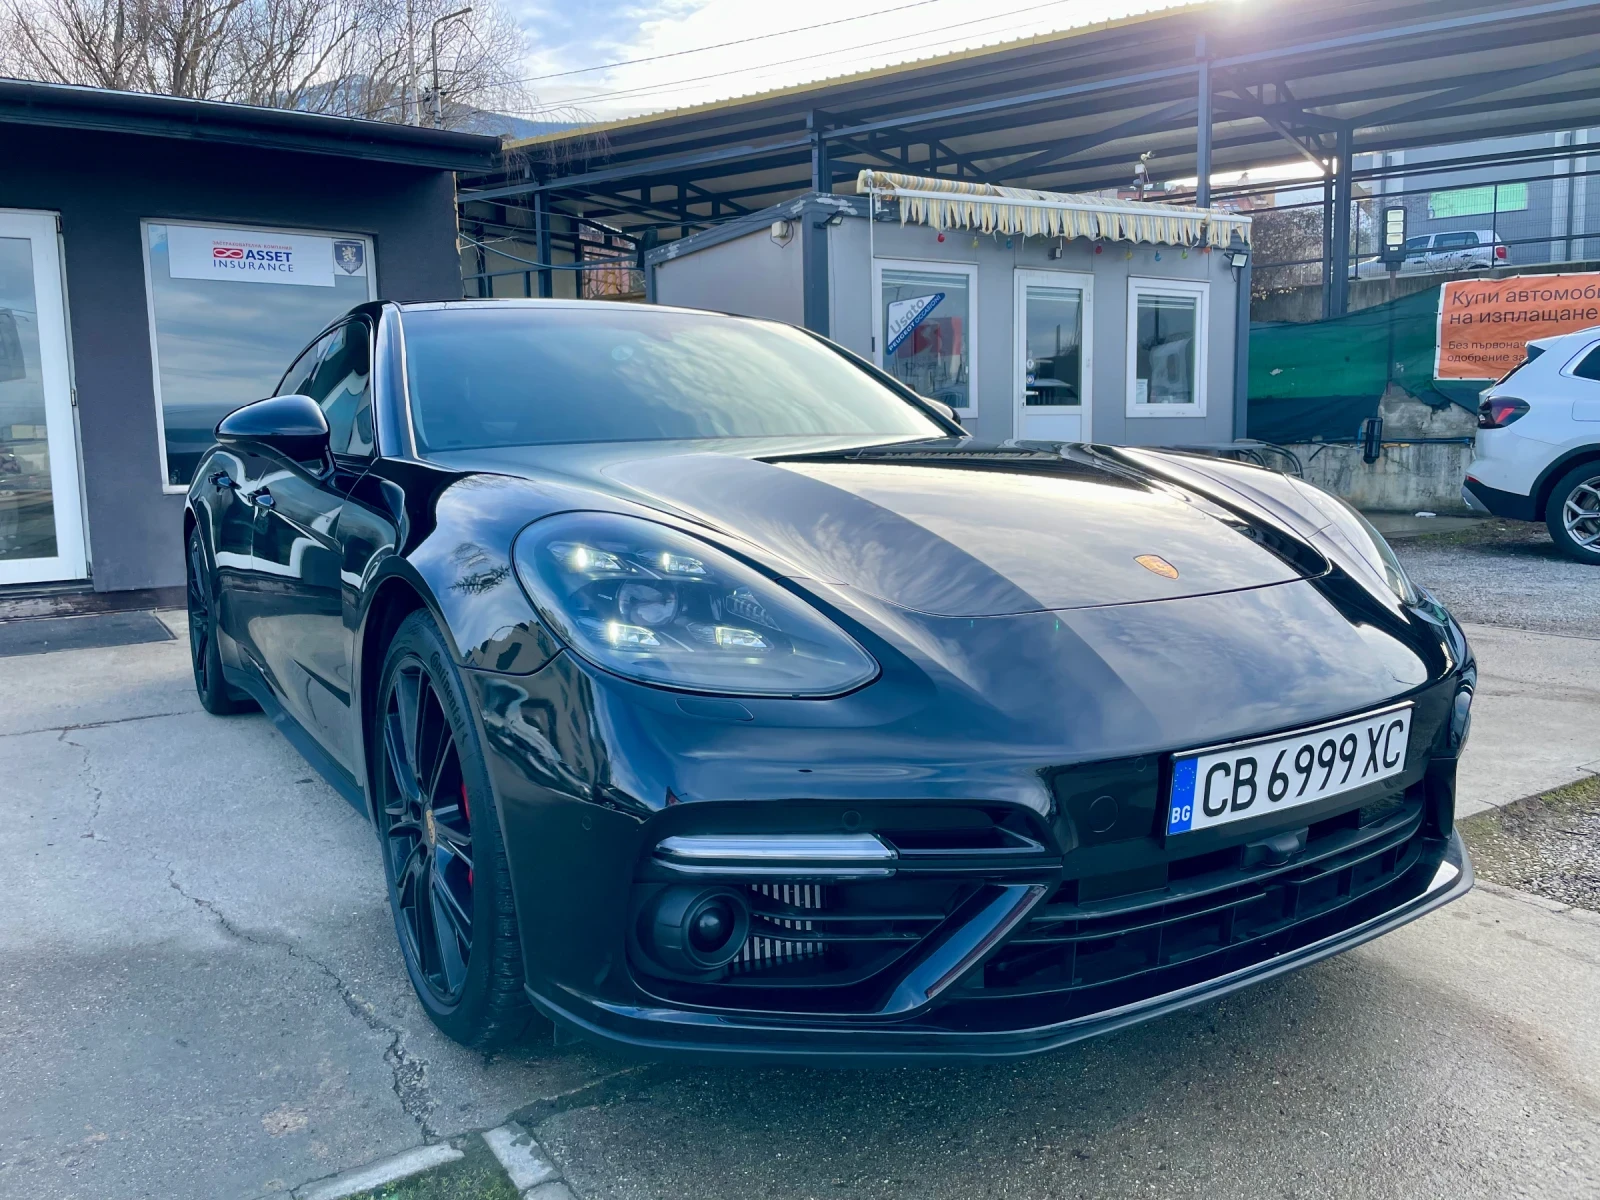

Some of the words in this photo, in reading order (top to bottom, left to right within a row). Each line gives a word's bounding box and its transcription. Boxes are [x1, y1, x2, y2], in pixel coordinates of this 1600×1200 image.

[246, 249, 292, 262] ASSET
[213, 259, 294, 273] INSURANCE
[1452, 289, 1499, 308] Купи
[889, 298, 925, 335] Usato
[1450, 313, 1473, 325] на
[1479, 307, 1598, 323] изплащане
[888, 321, 916, 352] PEUGEOT
[1448, 341, 1468, 350] Без
[1447, 353, 1509, 363] одобрение
[430, 651, 465, 732] Continental
[1202, 756, 1258, 817] CB
[1267, 732, 1358, 803] 6999
[1361, 718, 1404, 779] XC
[1171, 805, 1191, 824] BG
